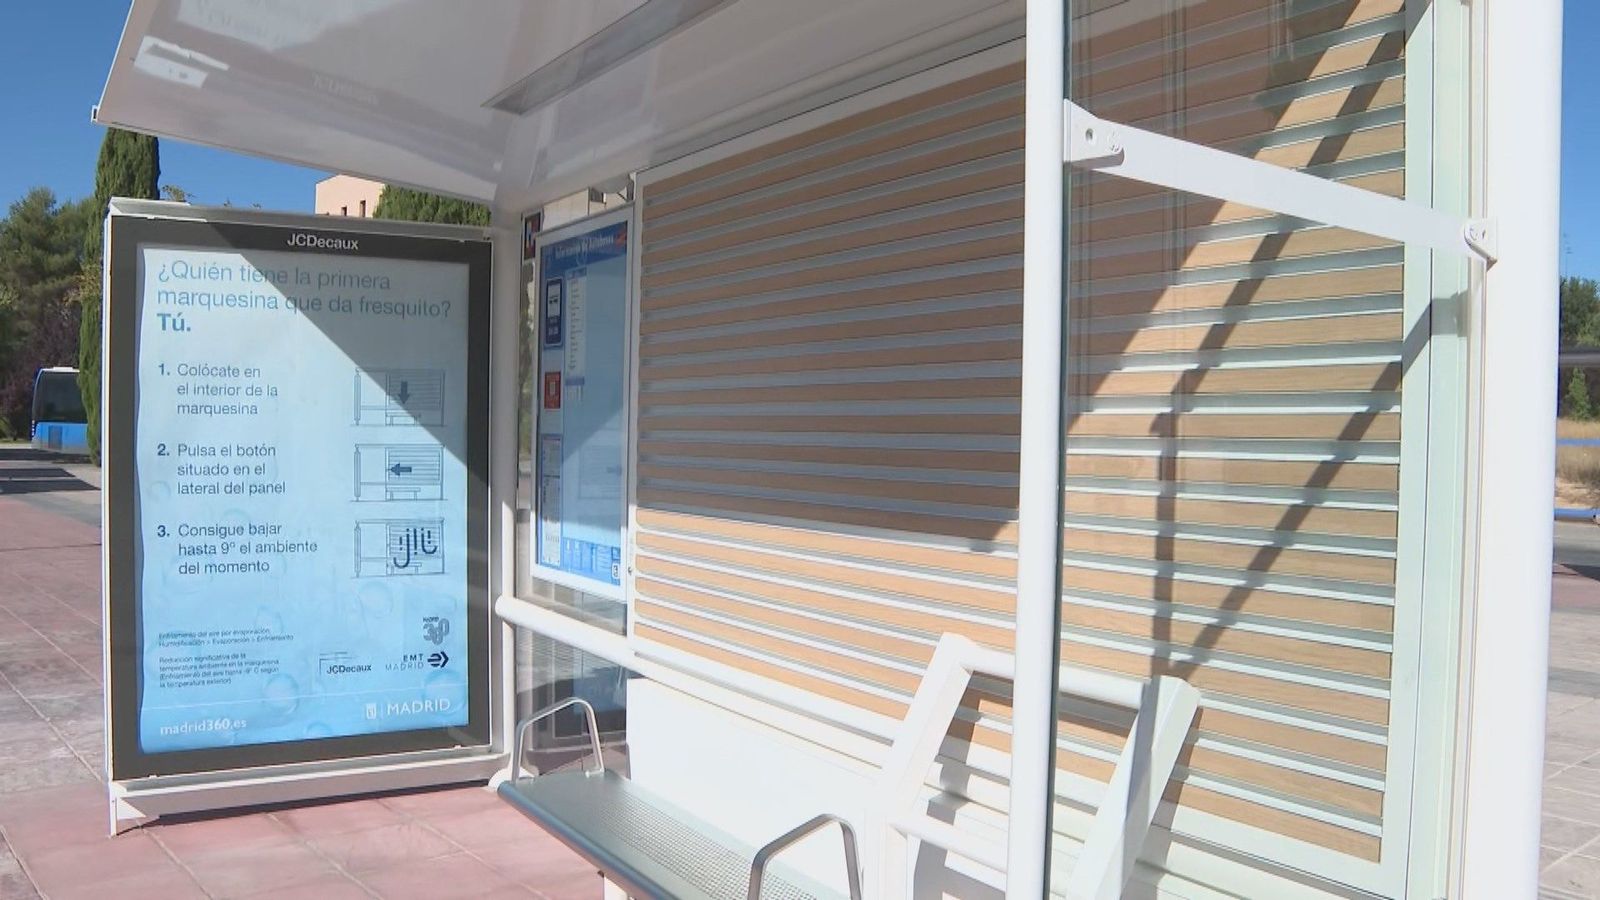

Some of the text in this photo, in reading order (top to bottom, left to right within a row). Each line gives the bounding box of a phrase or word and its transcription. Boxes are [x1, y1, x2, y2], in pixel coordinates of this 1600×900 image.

[287, 233, 359, 251] JCDecaux
[157, 260, 390, 290] ¿Quién tiene la primera
[157, 289, 451, 318] marquesina que da fresquito?
[157, 311, 191, 332] Tú.
[158, 364, 261, 378] 1. Colócate en
[176, 384, 278, 397] el interior de la
[176, 403, 258, 417] marquesina
[157, 443, 276, 458] 2. Pulsa el botón
[177, 463, 266, 476] situado en el
[177, 481, 286, 496] lateral del panel
[157, 523, 282, 540] 3. Consigue bajar
[178, 542, 217, 555] hasta
[239, 541, 251, 554] el
[255, 540, 318, 554] ambiente
[178, 560, 270, 575] del momento
[403, 653, 424, 662] EMT
[326, 665, 372, 675] JCDecaux
[385, 662, 424, 671] MADRID
[388, 698, 450, 715] MADRID
[160, 718, 247, 736] madrid360.es
